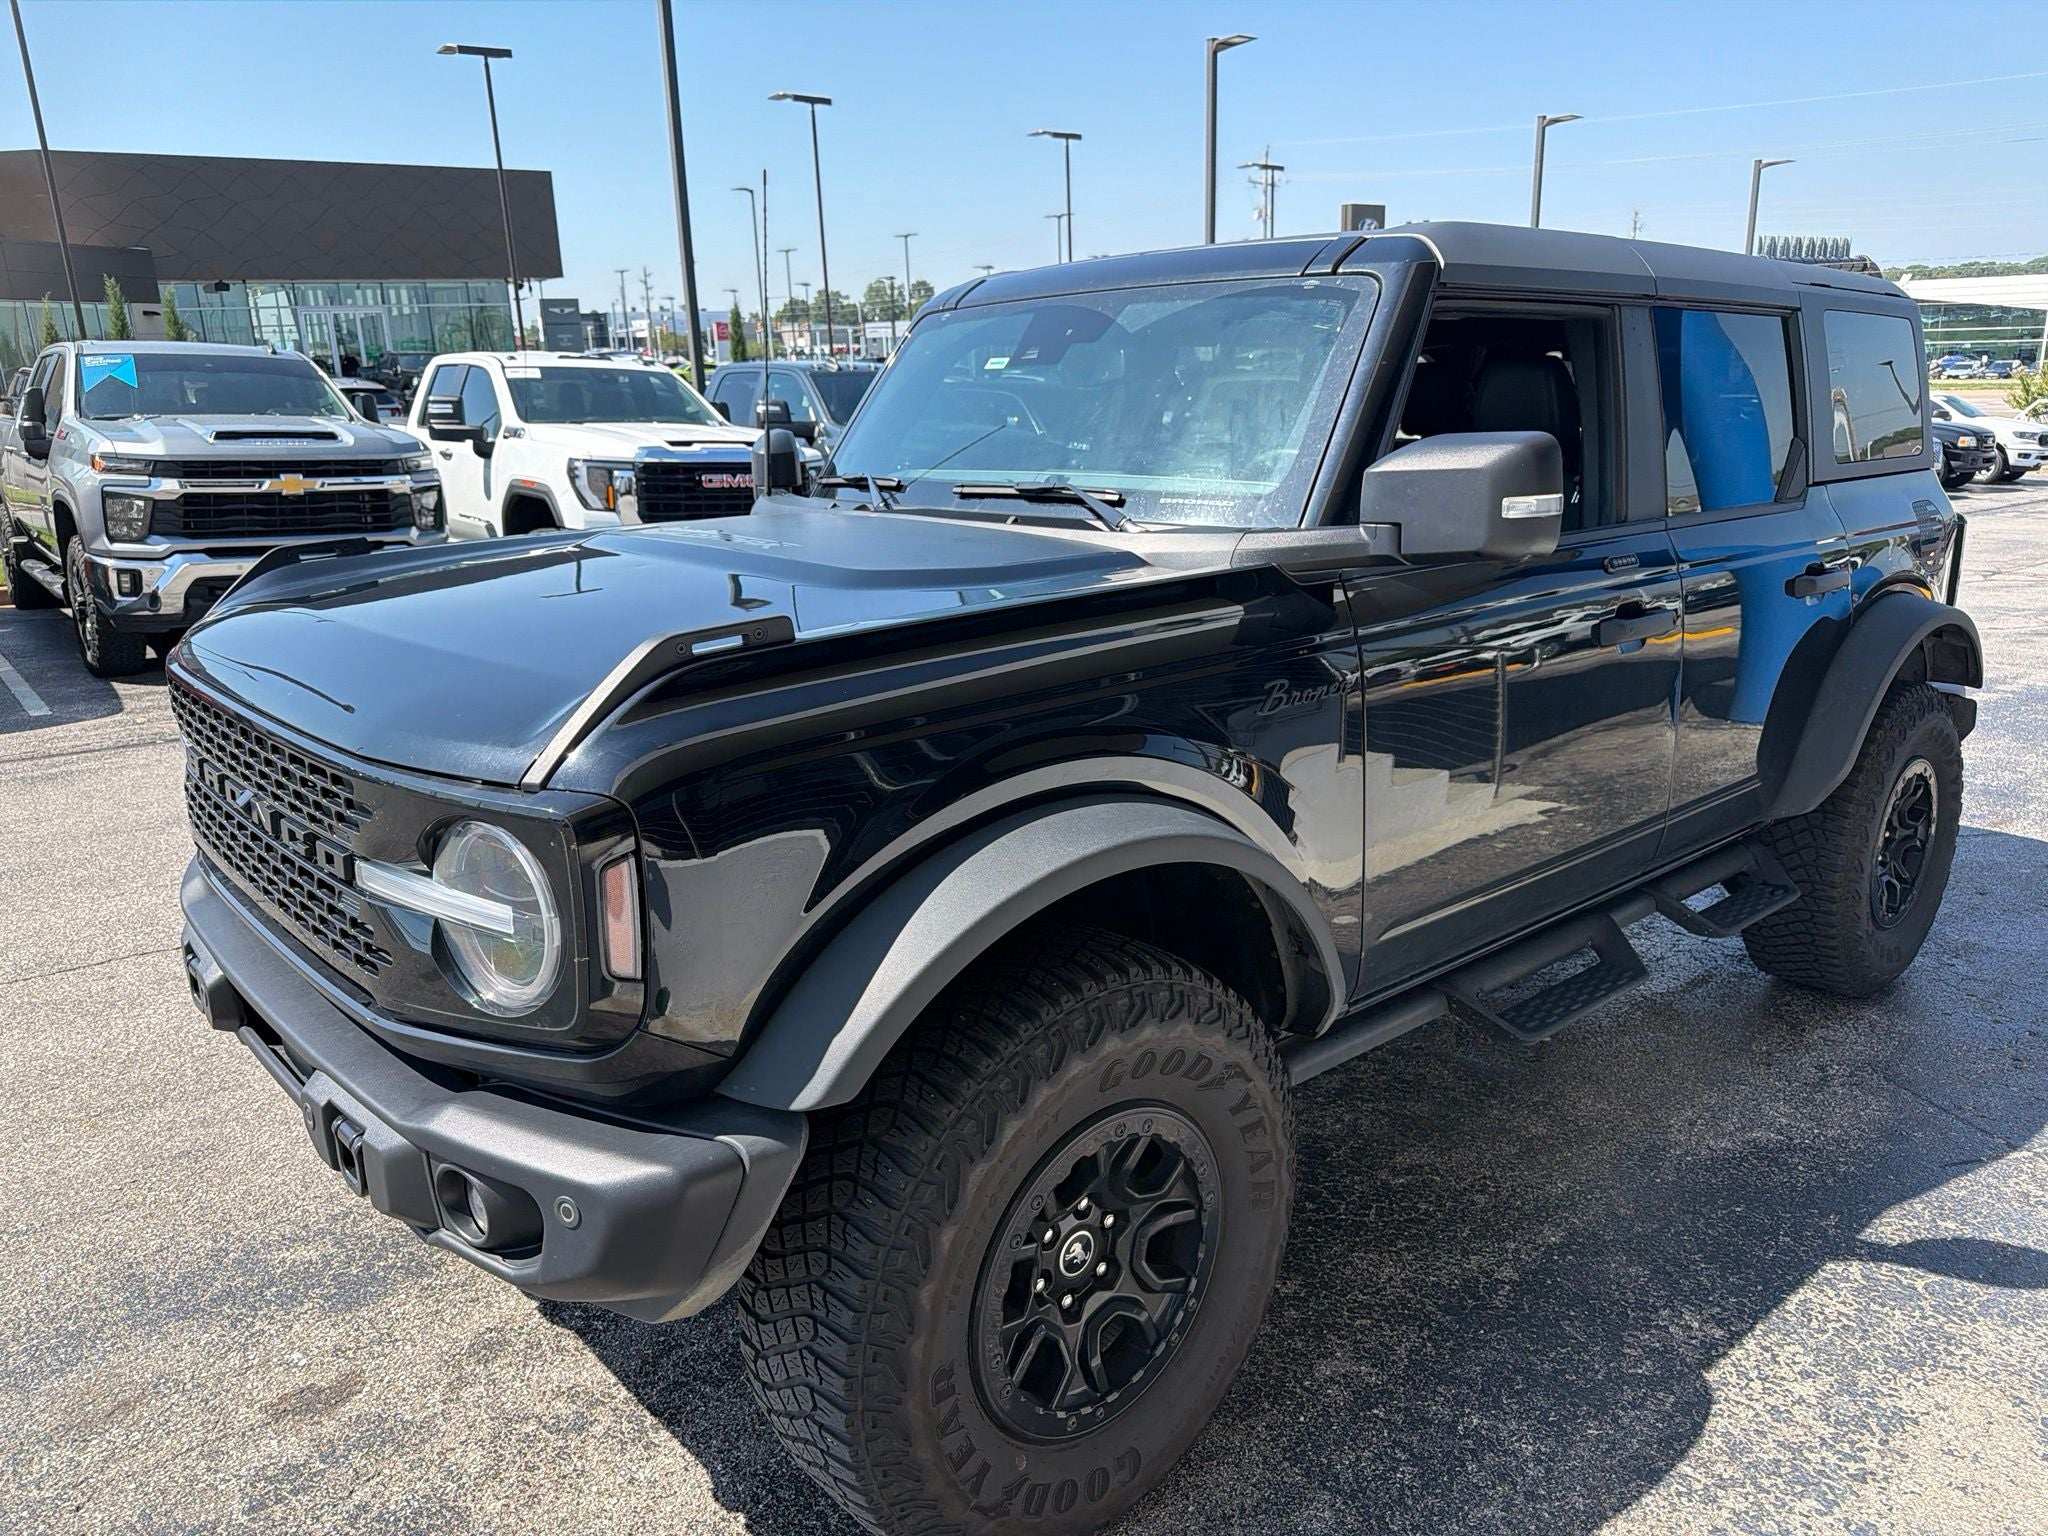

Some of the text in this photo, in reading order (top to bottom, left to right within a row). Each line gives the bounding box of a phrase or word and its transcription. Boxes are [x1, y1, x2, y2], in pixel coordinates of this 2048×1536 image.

[1159, 497, 1236, 507] BRONCO
[1255, 678, 1356, 716] Bronco
[186, 747, 354, 881] BRONCO
[1098, 1046, 1276, 1213] GOODYEAR
[929, 1360, 1143, 1521] GOODYEAR
